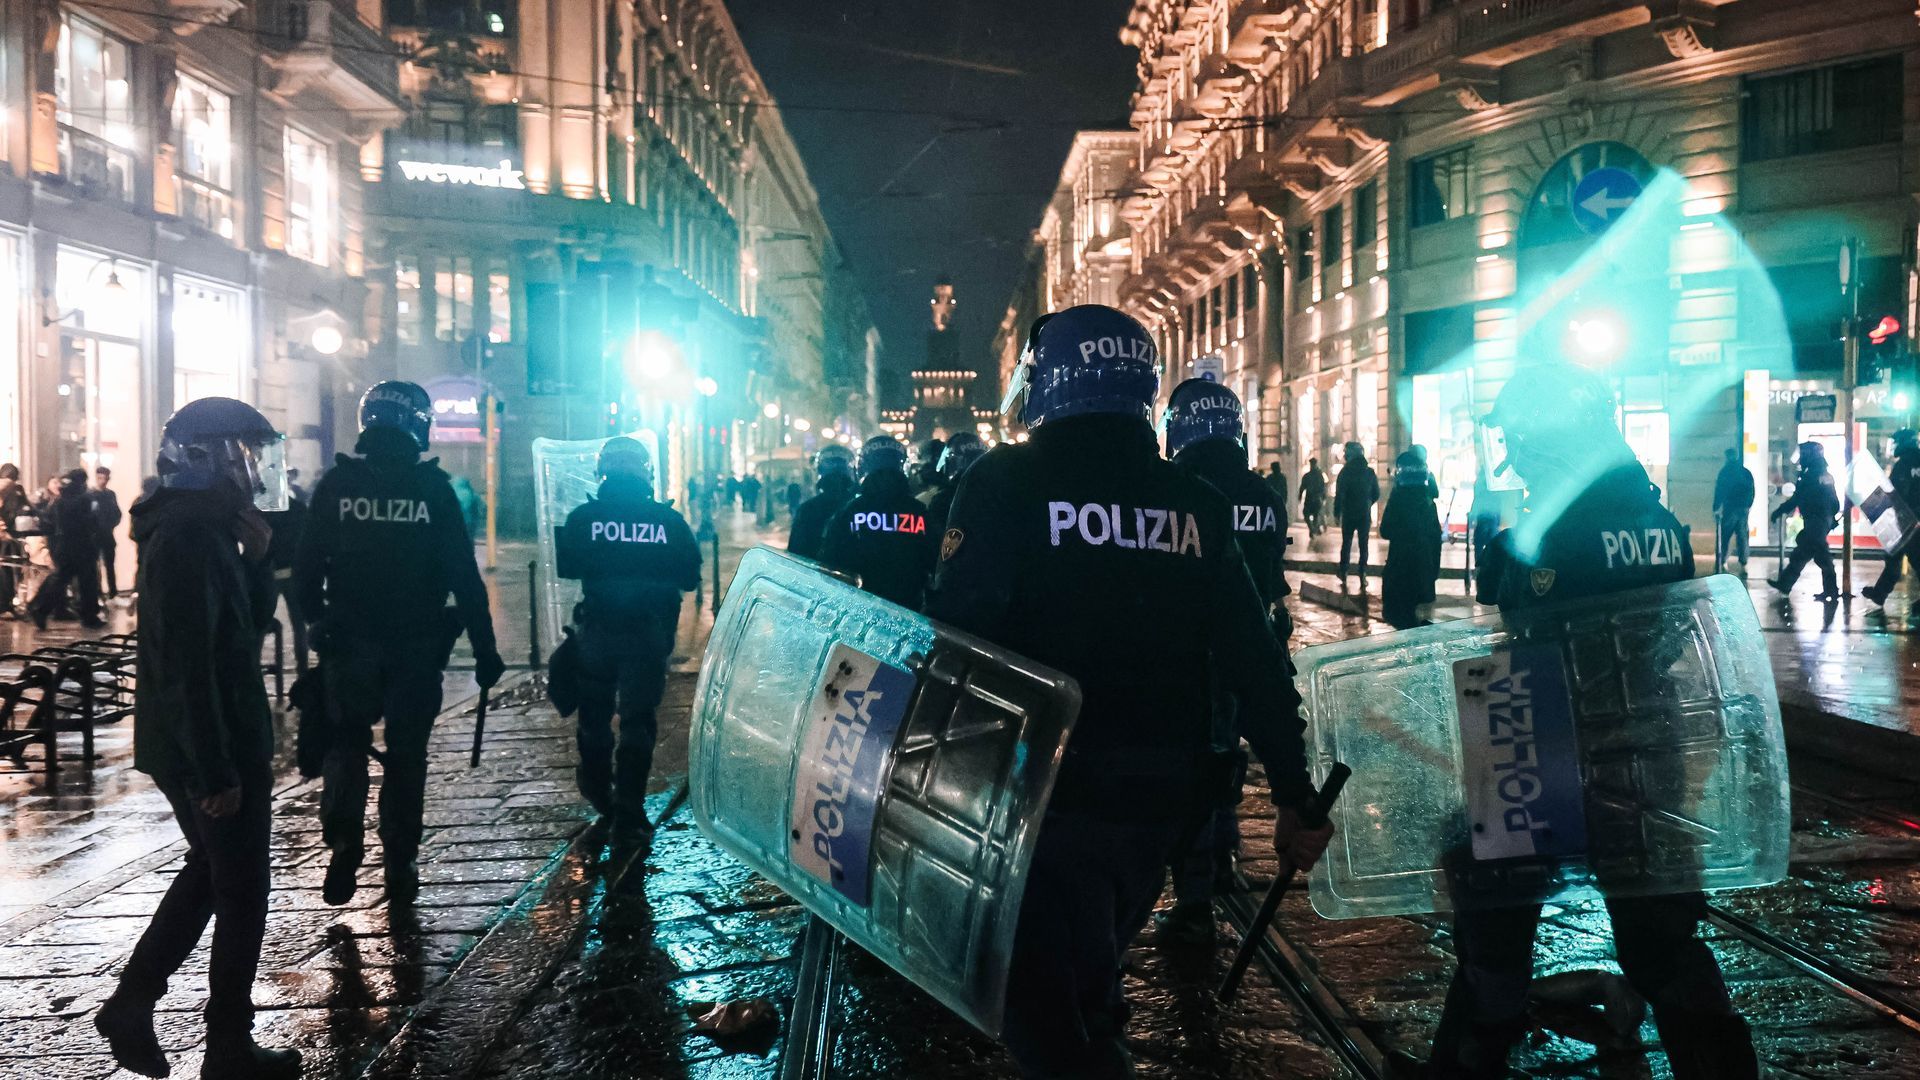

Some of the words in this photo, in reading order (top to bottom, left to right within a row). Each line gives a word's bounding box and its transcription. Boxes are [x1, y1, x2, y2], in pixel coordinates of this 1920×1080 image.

[398, 159, 525, 189] wework
[339, 497, 430, 523] POLIZIA
[853, 511, 926, 535] POLIZIA
[591, 521, 667, 544] POLIZIA
[1048, 501, 1202, 558] POLIZIA
[1601, 528, 1683, 569] POLIZIA
[1487, 668, 1549, 833] POLIZIA
[811, 689, 884, 871] POLIZIA
